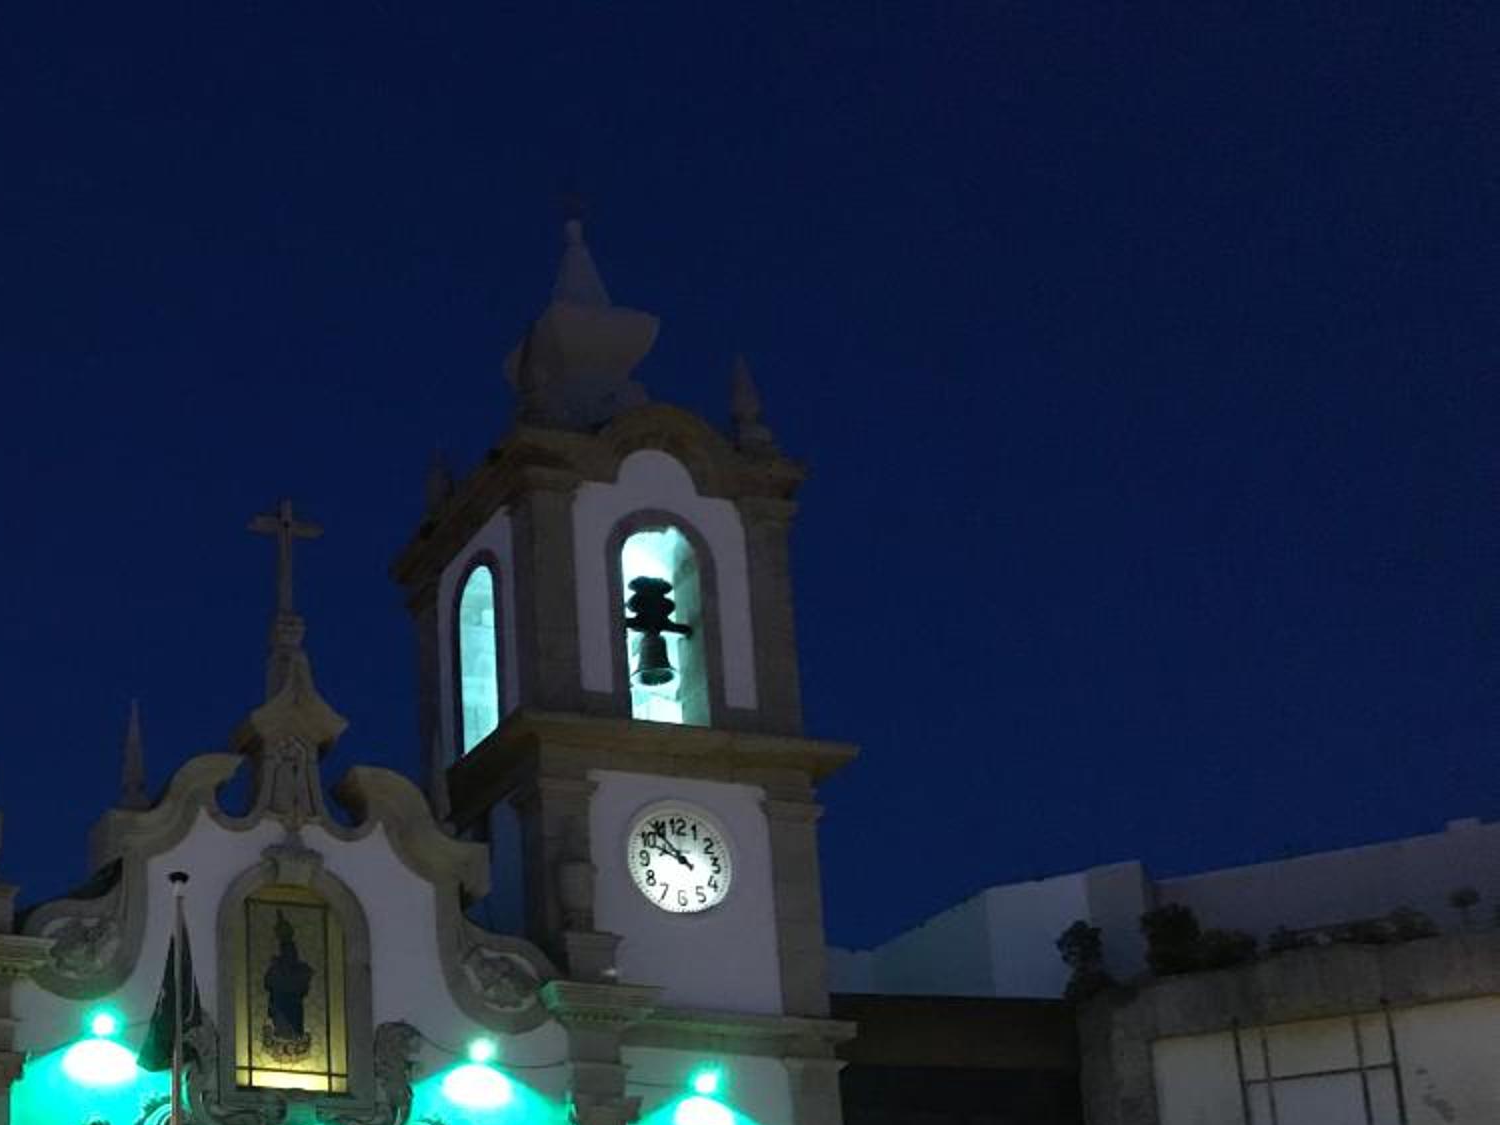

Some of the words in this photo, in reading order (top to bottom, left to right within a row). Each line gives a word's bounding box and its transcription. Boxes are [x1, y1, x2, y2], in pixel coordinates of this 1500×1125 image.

[669, 818, 687, 836] 12
[691, 824, 698, 841] 1
[641, 831, 657, 849] 10
[703, 838, 714, 854] 2
[640, 850, 651, 866] 9
[710, 857, 721, 874] 3
[646, 869, 657, 886] 8
[708, 876, 718, 892] 4
[660, 883, 669, 901] 7
[677, 889, 688, 907] 6
[696, 886, 707, 903] 5
